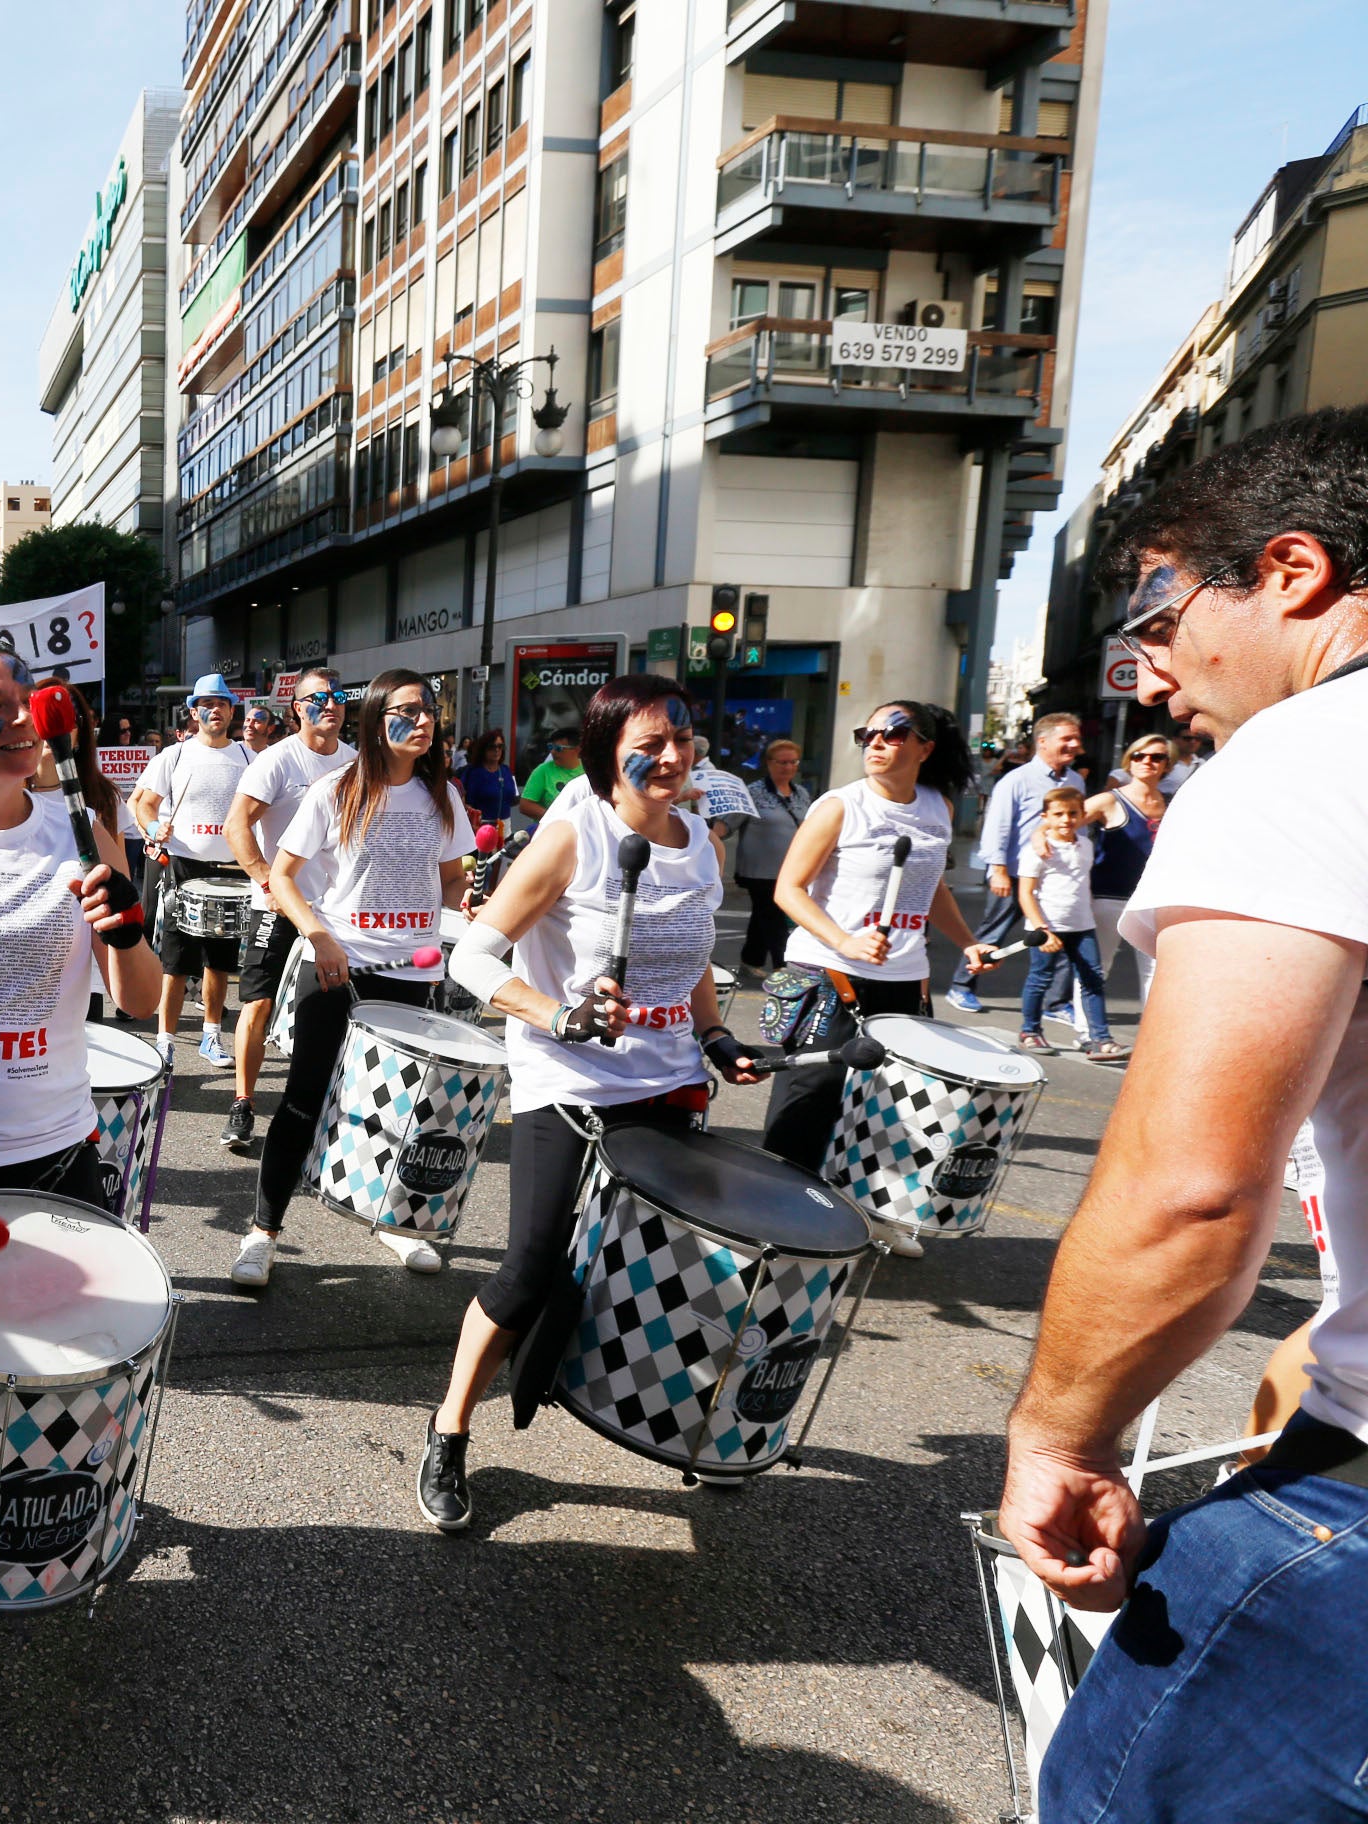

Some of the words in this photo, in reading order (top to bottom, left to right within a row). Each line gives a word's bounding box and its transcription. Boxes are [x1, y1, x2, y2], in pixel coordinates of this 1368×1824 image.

[873, 325, 928, 342] VENDO
[840, 342, 874, 360] 639
[881, 345, 916, 362] 579
[922, 347, 958, 365] 299
[398, 608, 449, 637] MANGO
[539, 668, 609, 686] Cóndor
[1116, 670, 1137, 680] 30
[100, 750, 150, 762] TERUEL
[350, 912, 434, 929] ¡EXISTE!
[6, 1062, 48, 1074] #SalvemosTeruel
[406, 1142, 466, 1170] BATUCADA
